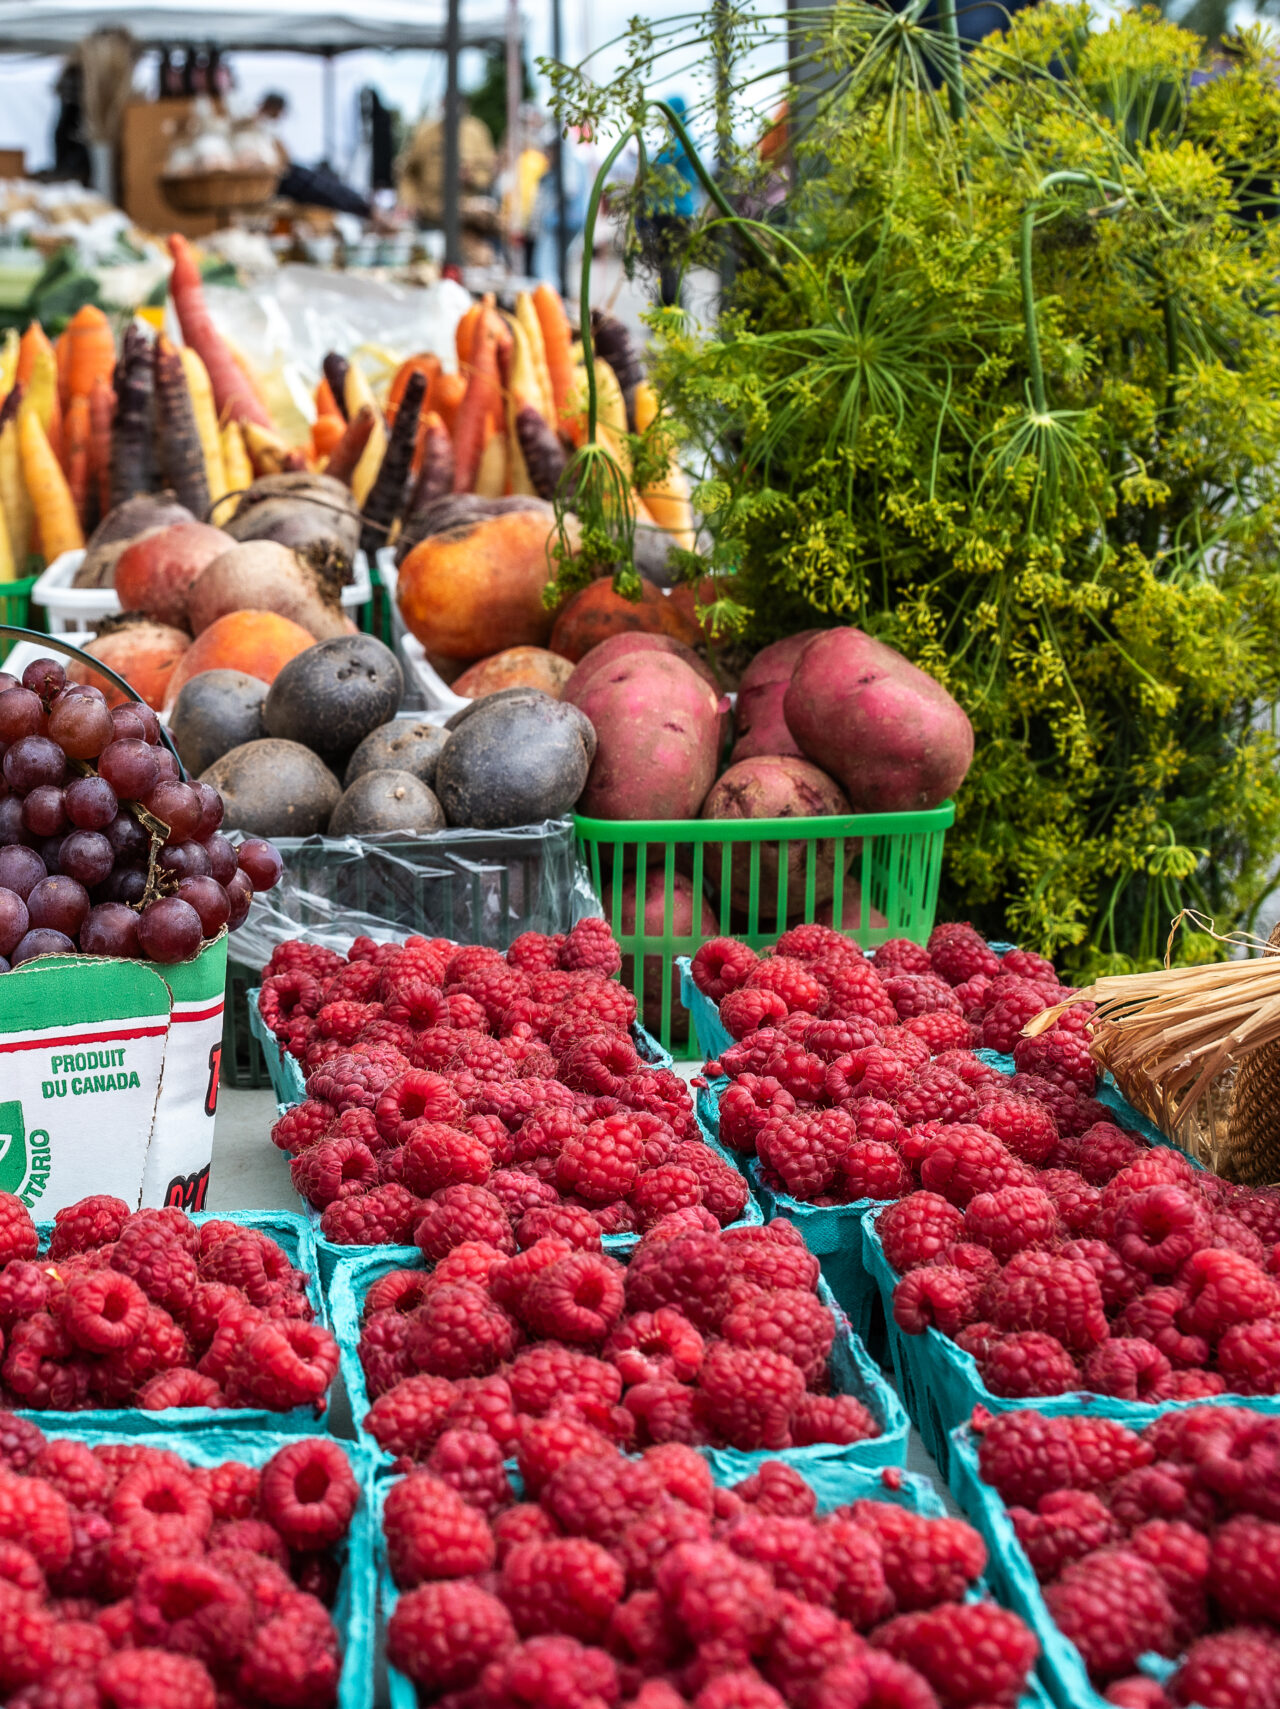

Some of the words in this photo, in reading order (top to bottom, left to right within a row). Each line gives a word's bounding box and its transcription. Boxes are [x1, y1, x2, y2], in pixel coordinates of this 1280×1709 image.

[51, 1048, 126, 1074] PRODUIT
[41, 1079, 67, 1099] DU
[71, 1071, 140, 1095] CANADA
